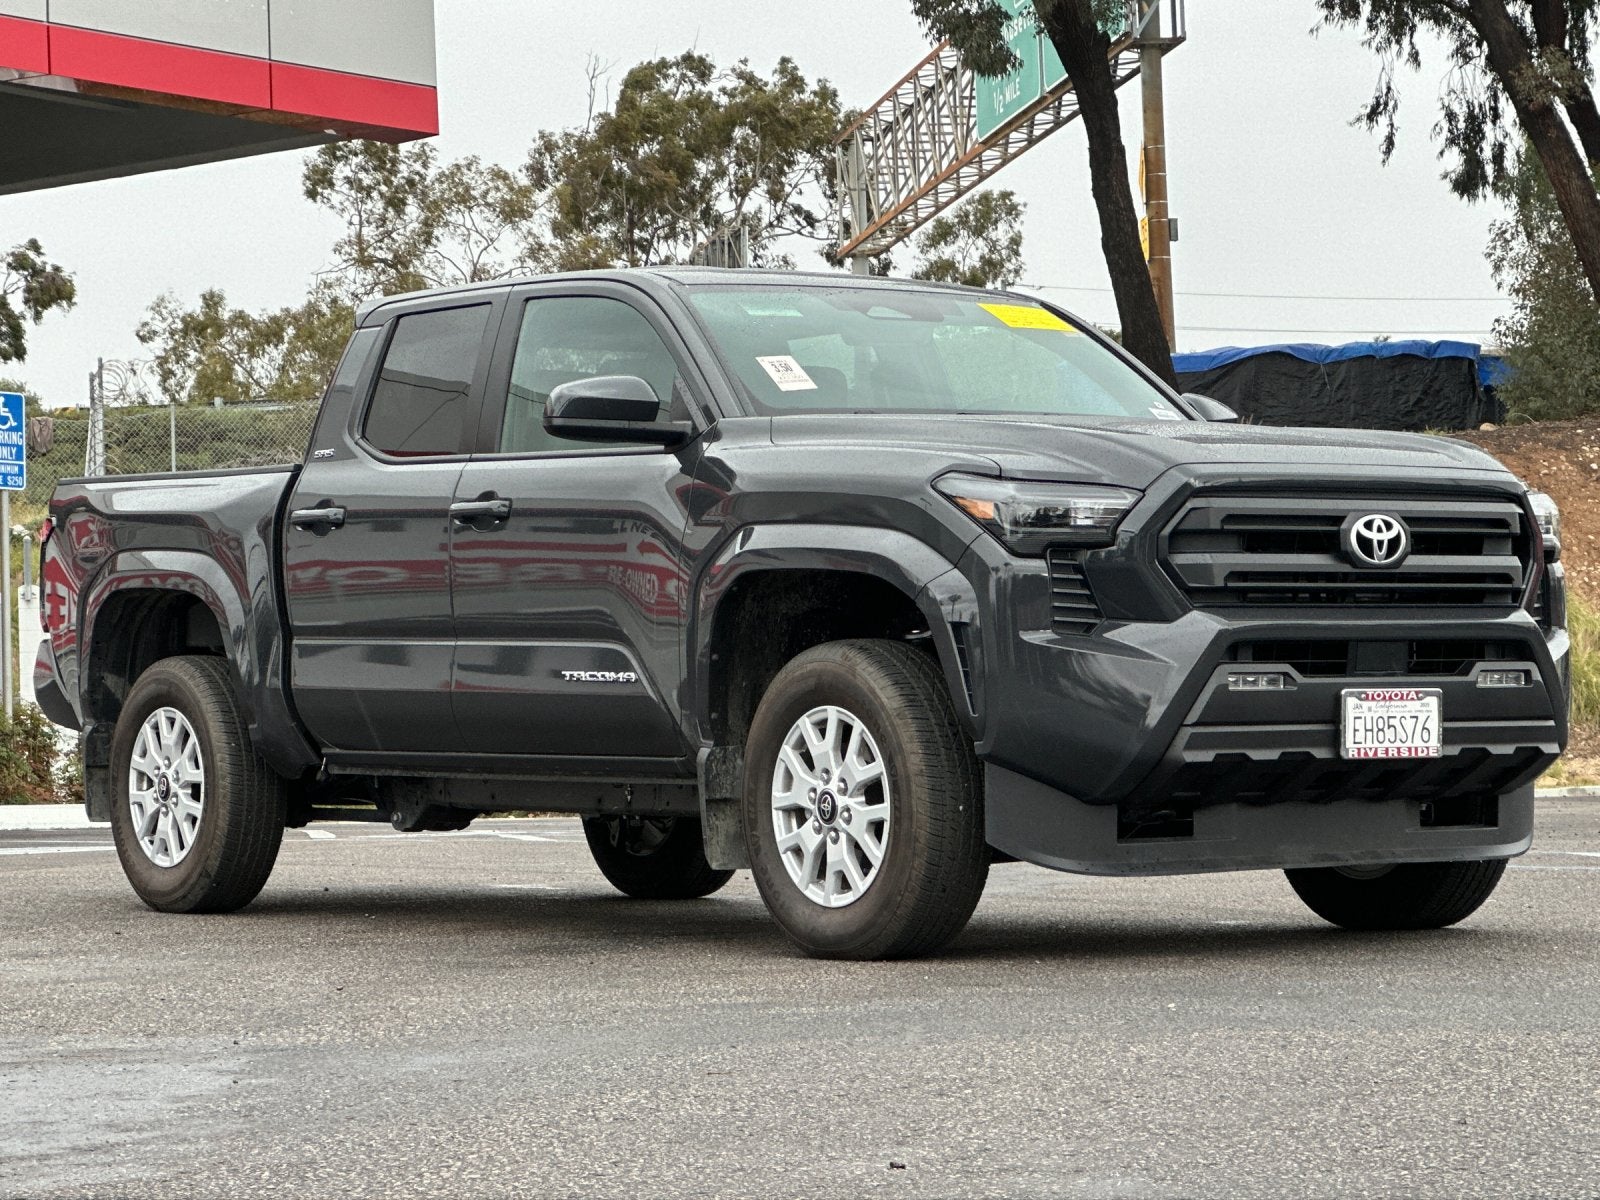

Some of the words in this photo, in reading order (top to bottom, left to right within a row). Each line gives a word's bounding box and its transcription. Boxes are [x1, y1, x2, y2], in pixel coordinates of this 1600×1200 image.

[1005, 77, 1021, 104] MILE
[0, 431, 23, 445] RKING
[7, 476, 23, 486] $250
[561, 671, 636, 682] TACOMA
[1366, 691, 1417, 701] TOYOTA
[1353, 715, 1431, 745] EH85S76
[1348, 747, 1438, 758] RIVERSIDE
